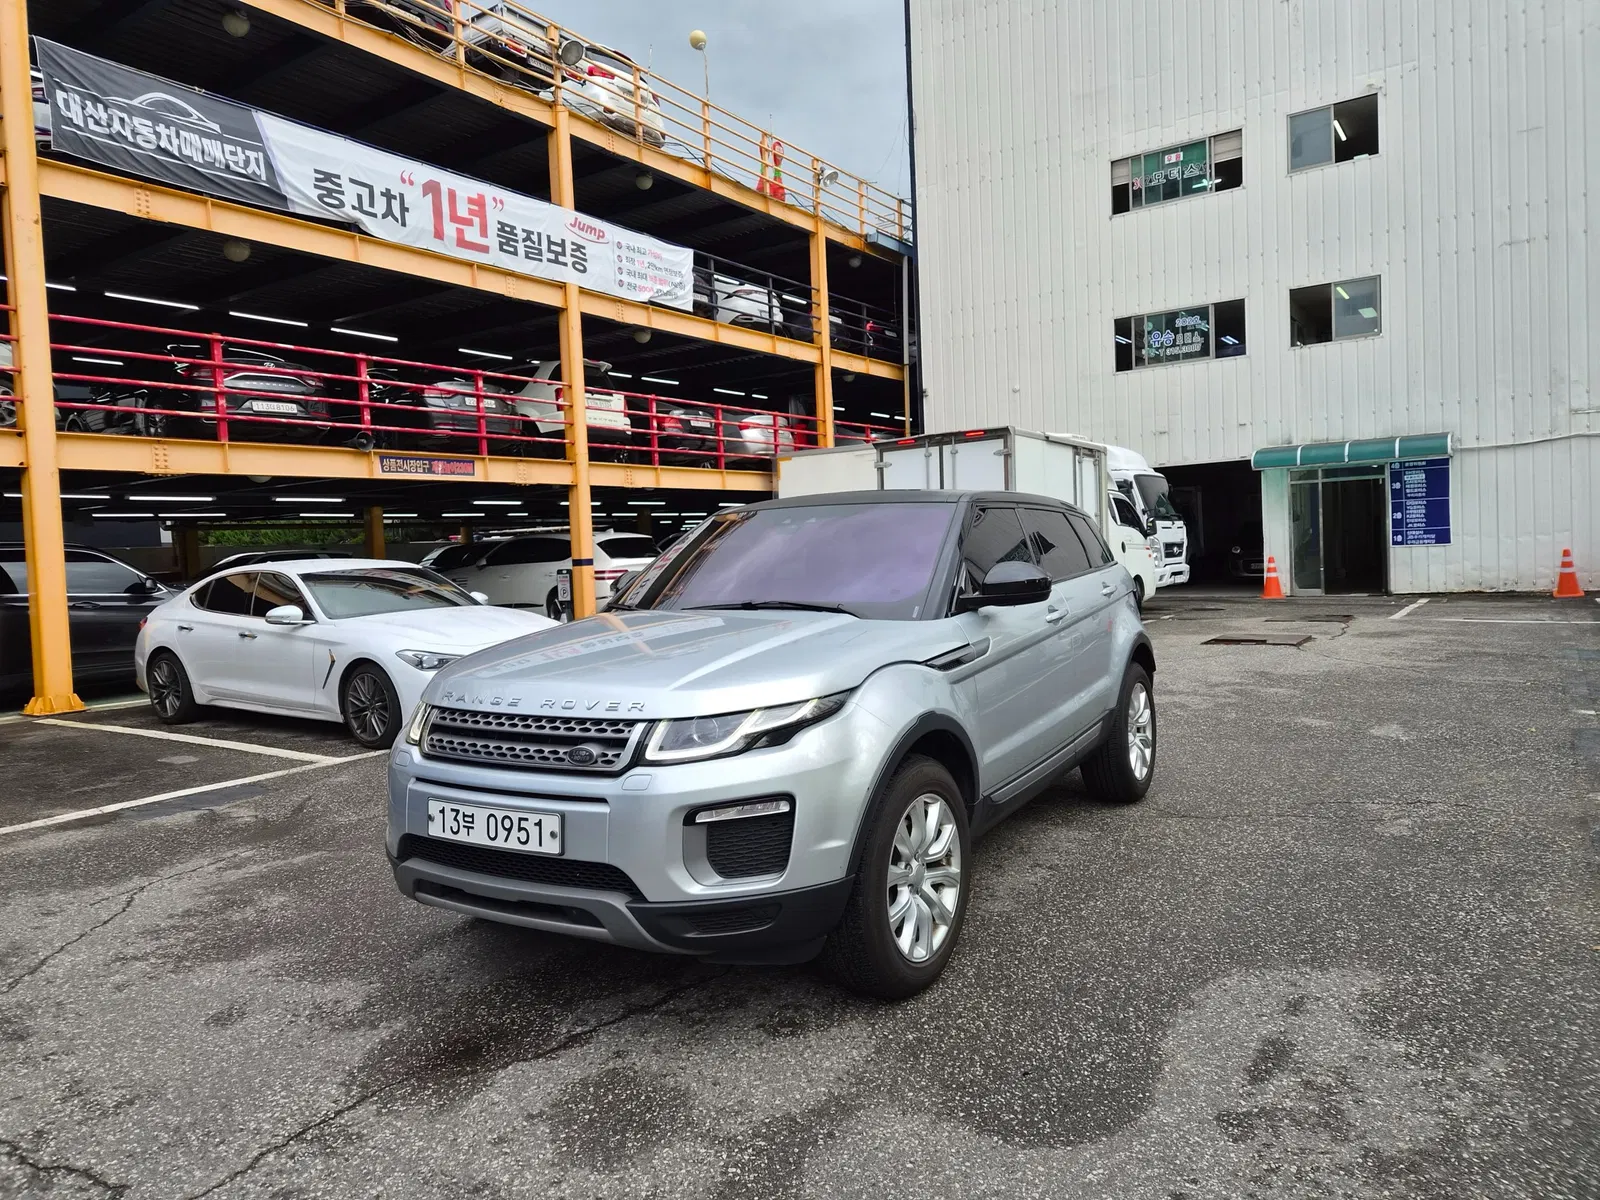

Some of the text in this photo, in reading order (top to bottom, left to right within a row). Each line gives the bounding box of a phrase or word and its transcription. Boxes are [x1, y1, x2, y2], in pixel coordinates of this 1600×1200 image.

[55, 89, 267, 181] 대산자동차매매단지
[1151, 163, 1199, 186] 모터스
[313, 168, 410, 228] 중고차
[496, 219, 588, 274] 품질보증
[569, 217, 606, 241] Jump
[383, 458, 430, 473] 상품전시장입구
[441, 691, 647, 712] RANGE ROVER
[438, 806, 543, 847] 13부 0951
